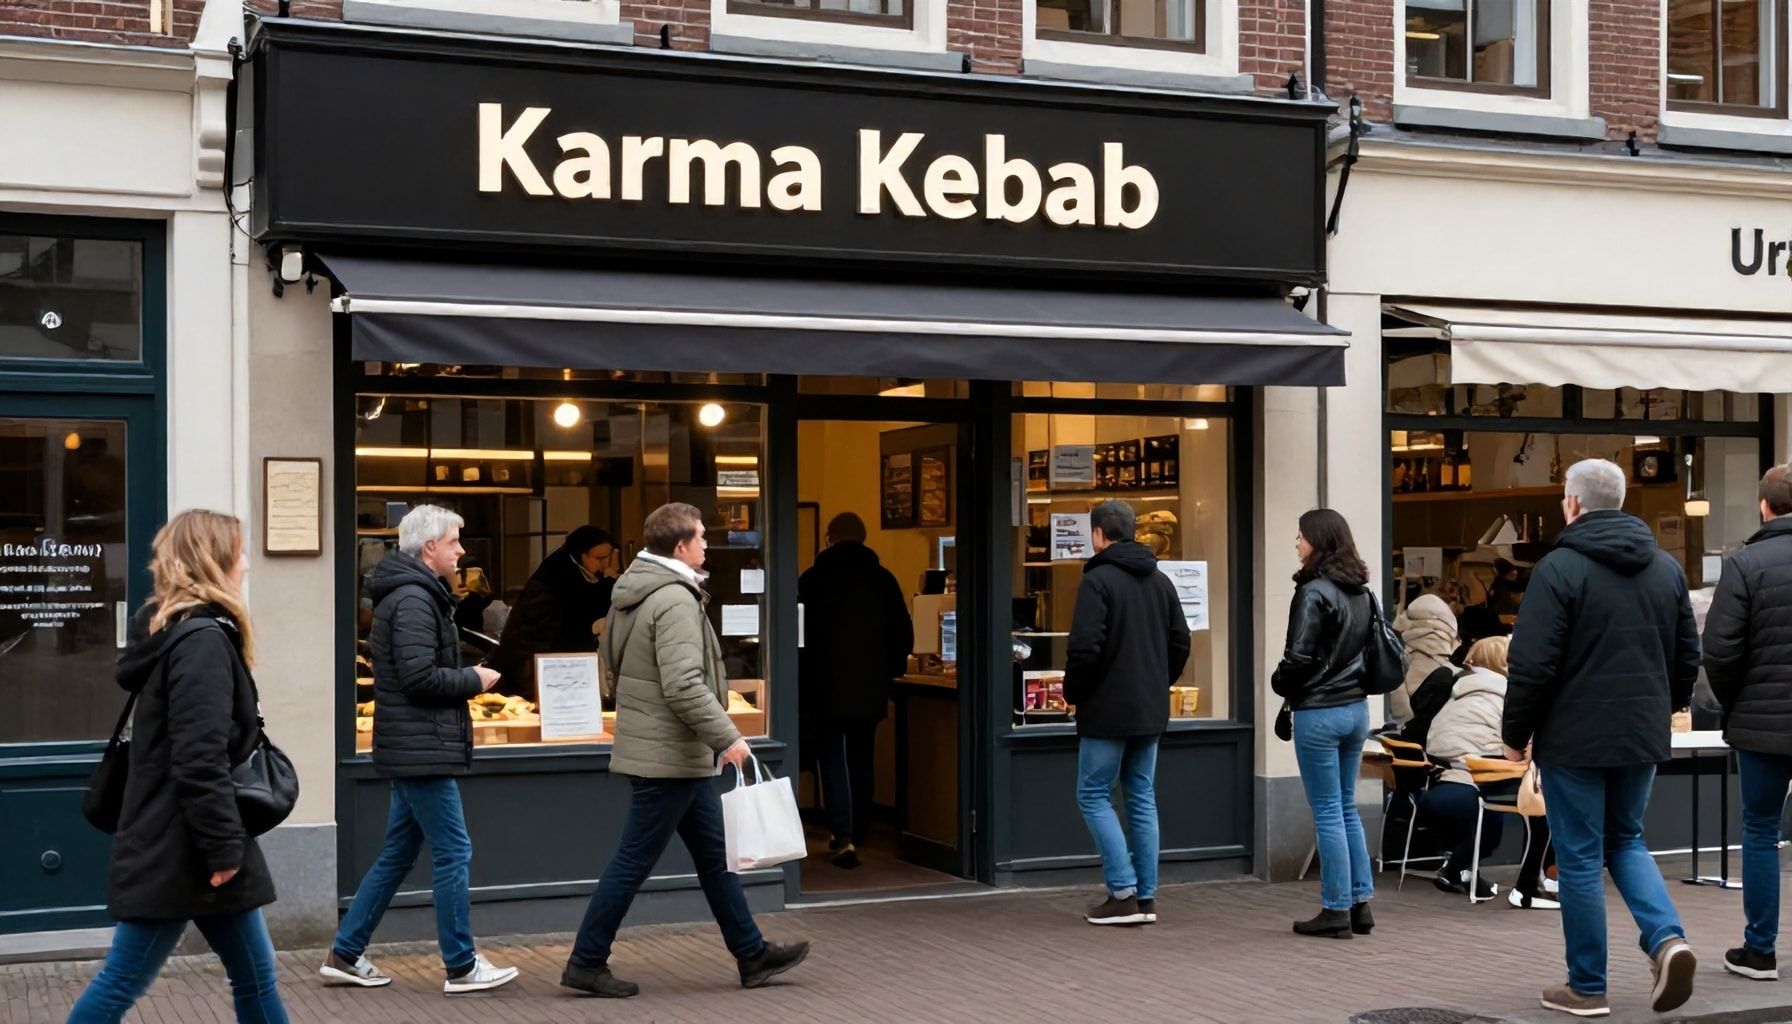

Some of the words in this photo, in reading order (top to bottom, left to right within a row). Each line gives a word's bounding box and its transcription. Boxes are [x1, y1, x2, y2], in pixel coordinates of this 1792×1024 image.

[477, 102, 822, 212] Karma
[857, 128, 1160, 229] Kebab
[1731, 227, 1792, 279] Ur
